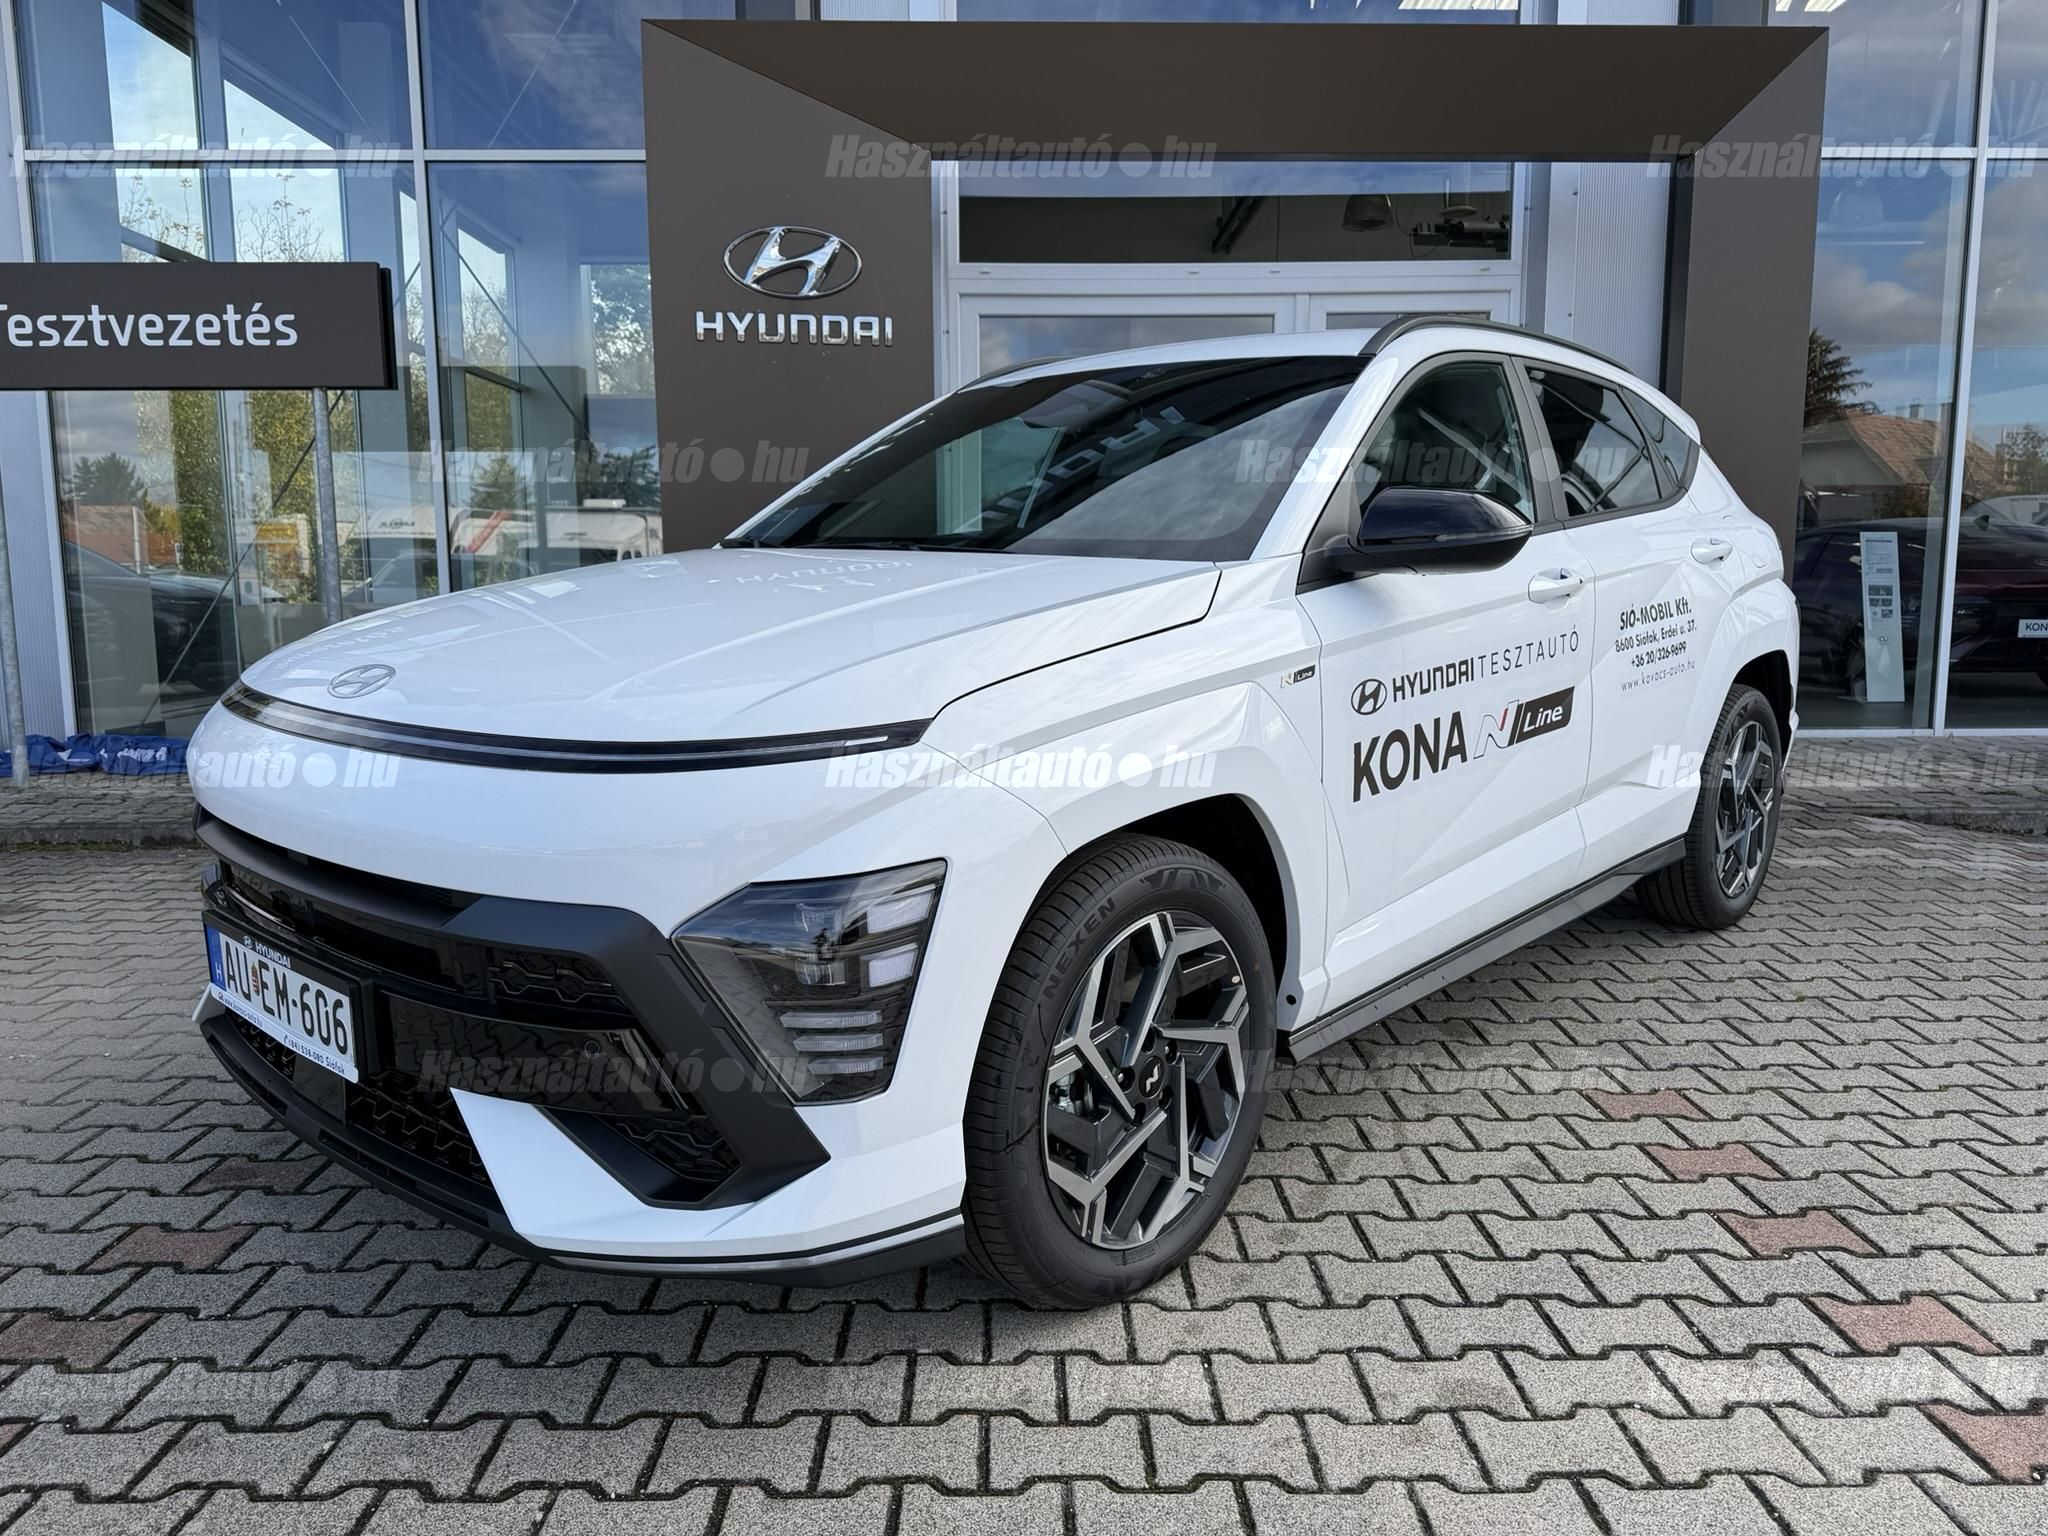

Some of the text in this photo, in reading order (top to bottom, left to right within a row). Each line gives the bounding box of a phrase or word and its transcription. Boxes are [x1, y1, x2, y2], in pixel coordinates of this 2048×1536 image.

[0, 303, 298, 347] esztvezetés
[695, 310, 894, 348] HYUNDAI
[1620, 596, 1692, 631] SIÓ-MOBIL Kft.
[1615, 636, 1635, 653] 8600
[1660, 623, 1679, 641] Erdei
[1393, 624, 1580, 702] HYUNDAI TESZTAUTÓ
[1352, 711, 1468, 803] KONA
[1522, 704, 1563, 733] Line
[255, 941, 291, 969] HYUNDAI
[1043, 896, 1118, 999] NEXEN
